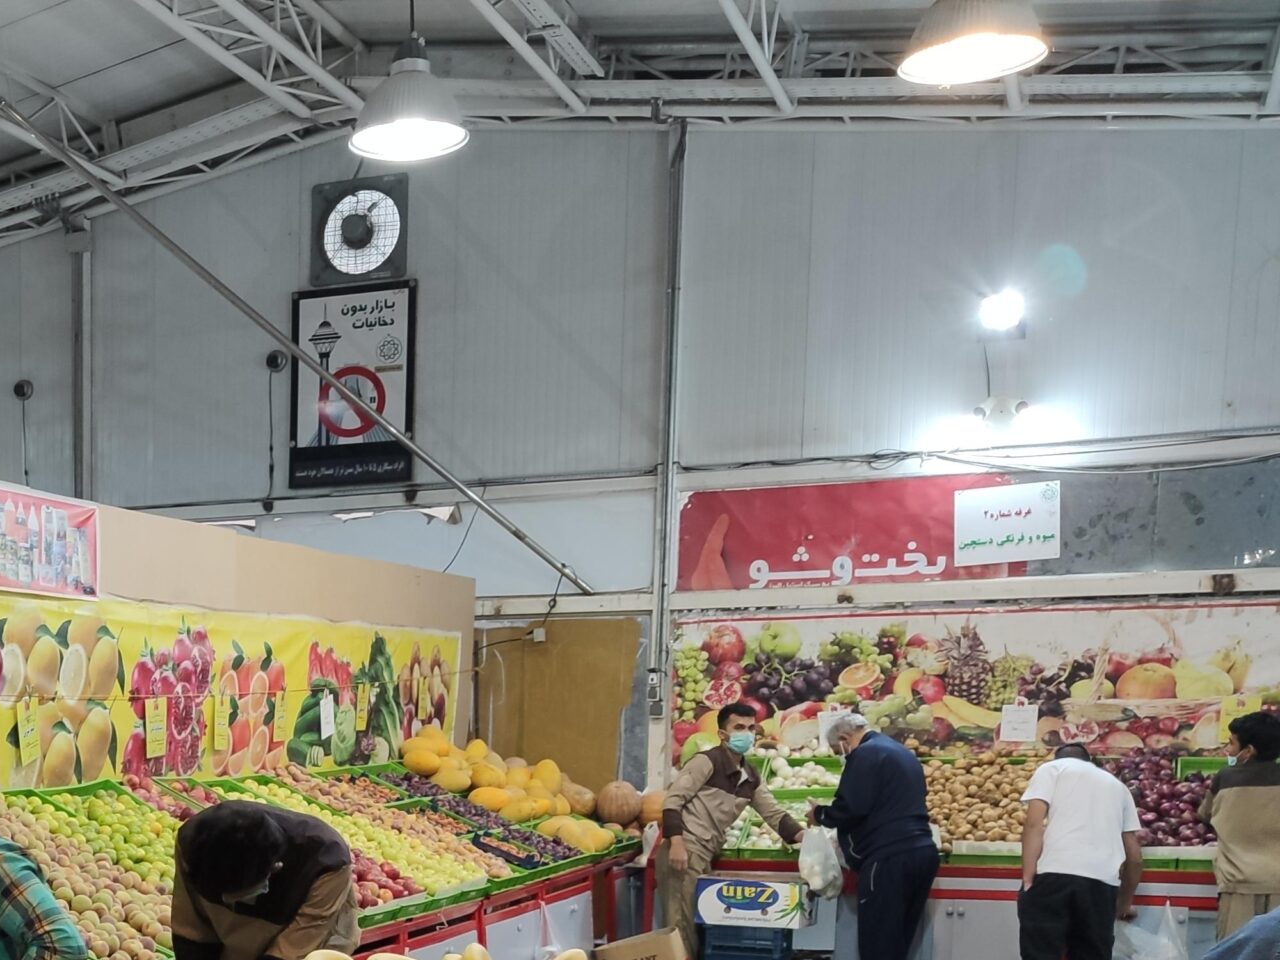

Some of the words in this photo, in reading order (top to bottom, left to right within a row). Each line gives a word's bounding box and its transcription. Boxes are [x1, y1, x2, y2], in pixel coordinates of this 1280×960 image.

[341, 303, 368, 317] بدون
[370, 299, 396, 315] بازار
[352, 316, 395, 331] دخانیات
[990, 509, 1012, 521] شماره
[1014, 506, 1032, 518] غرفه
[958, 537, 993, 550] دستچین
[996, 532, 1025, 547] فرنگی
[1028, 535, 1033, 544] و
[1035, 533, 1056, 543] میوه
[722, 884, 775, 904] Zain
